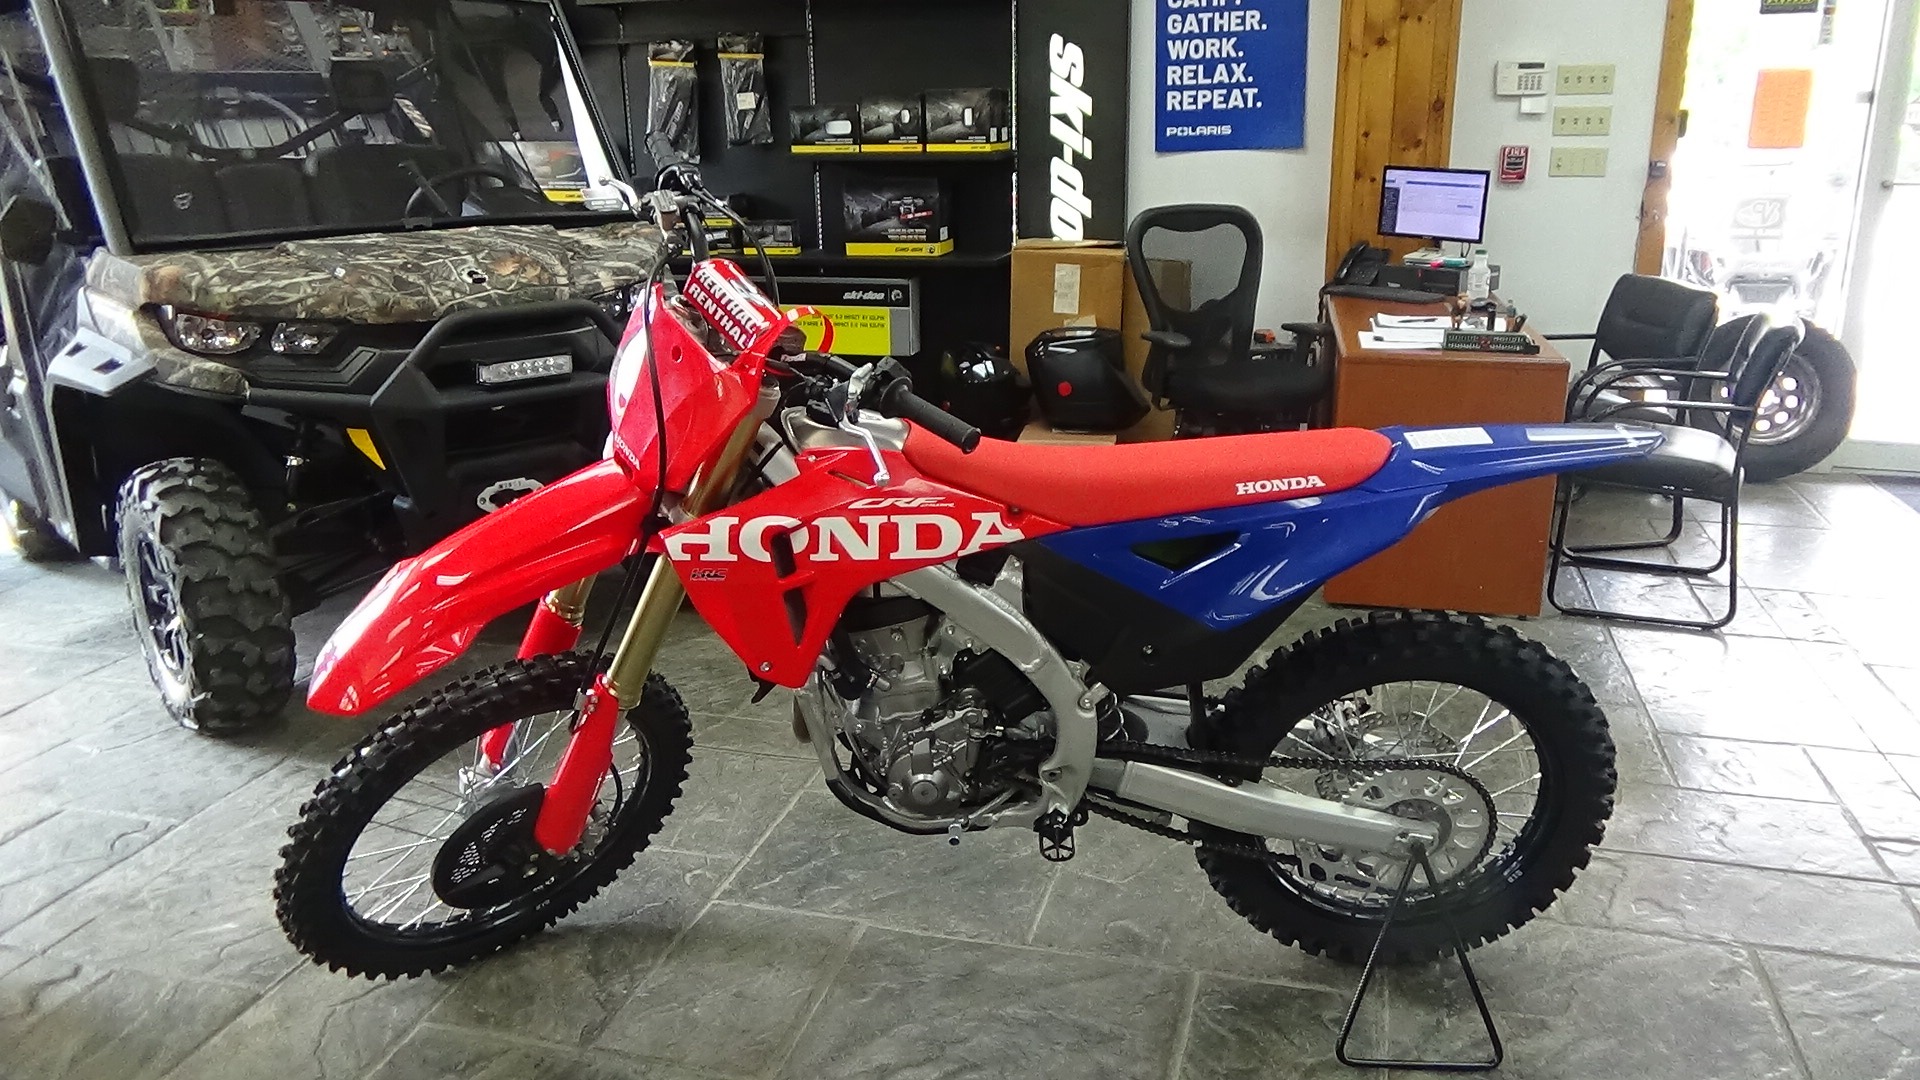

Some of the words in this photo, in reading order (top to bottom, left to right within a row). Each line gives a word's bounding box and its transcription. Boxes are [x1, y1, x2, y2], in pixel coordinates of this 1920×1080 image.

[1167, 10, 1267, 34] GATHER.
[1167, 37, 1244, 60] WORK.
[1166, 62, 1254, 86] RELAX.
[1166, 88, 1263, 111] REPEAT.
[1050, 33, 1092, 241] ski-do
[1166, 125, 1232, 136] POLARIS
[695, 268, 758, 334] RENTHAL
[688, 283, 749, 349] RENTHAL
[614, 431, 641, 470] HONDA
[1236, 475, 1326, 496] HONDA
[848, 497, 946, 509] CRF
[665, 511, 1025, 562] HONDA
